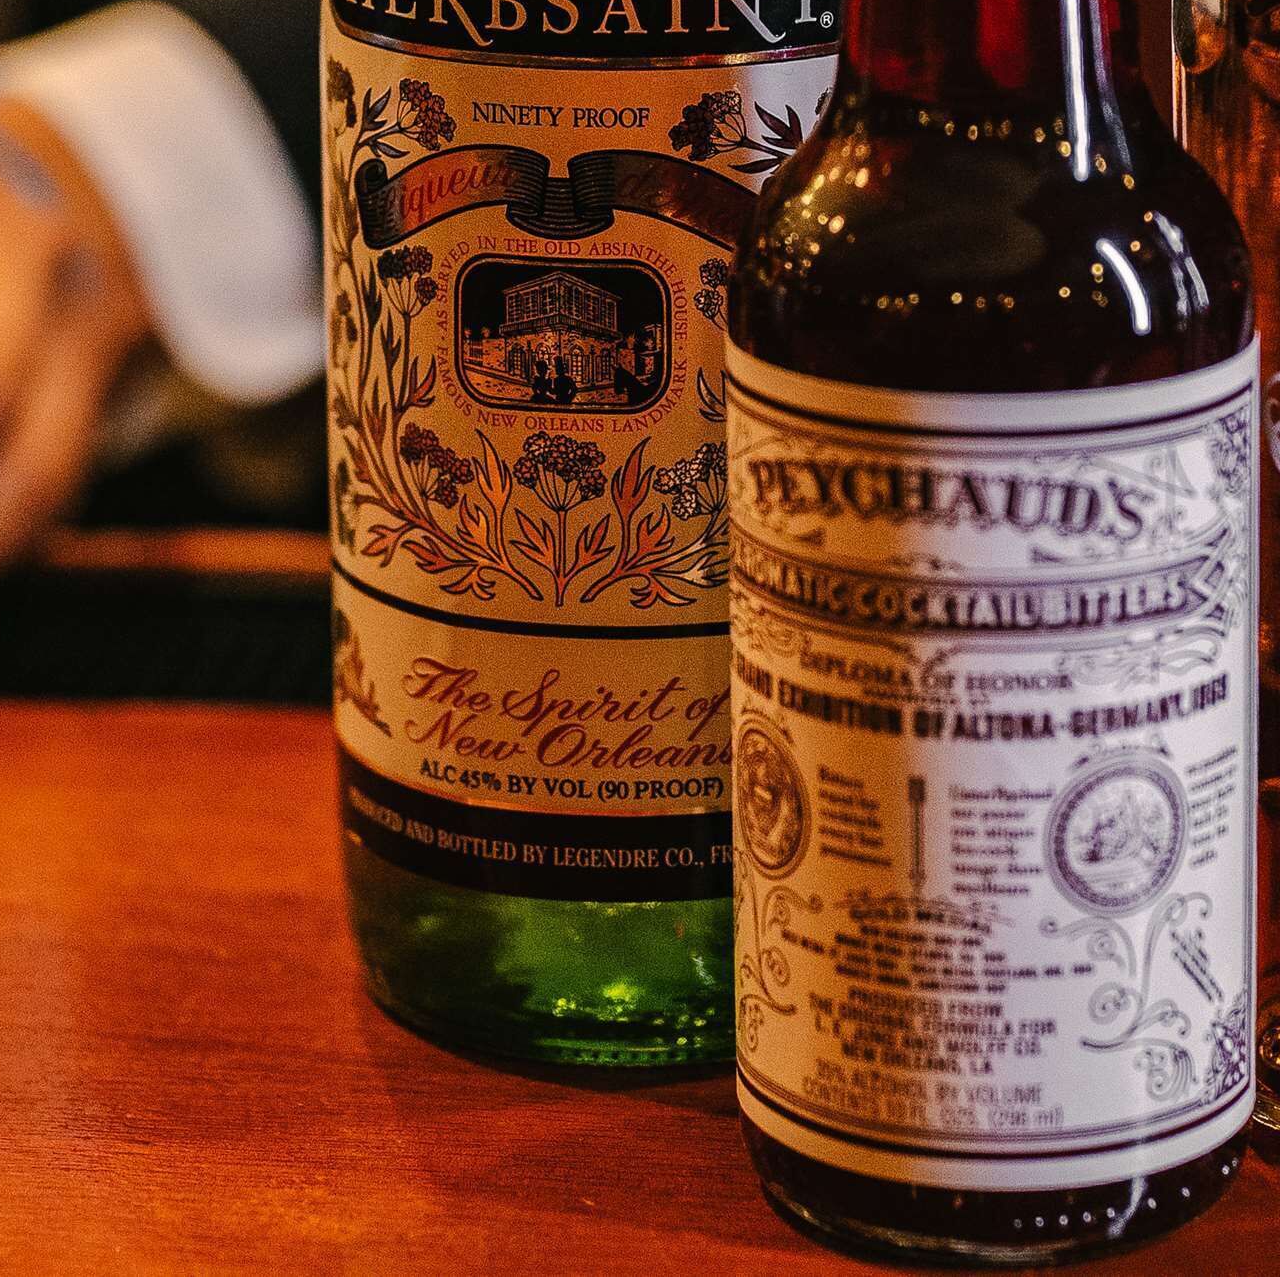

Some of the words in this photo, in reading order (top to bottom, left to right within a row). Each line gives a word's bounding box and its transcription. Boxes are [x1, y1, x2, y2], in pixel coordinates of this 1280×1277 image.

[471, 101, 564, 129] NINETY
[572, 106, 652, 129] PROOF
[478, 235, 497, 251] IN
[503, 238, 538, 253] THE
[544, 241, 581, 255] OLD
[588, 241, 679, 278] ABSINTHE
[436, 240, 470, 305] SERVED
[436, 309, 449, 333] AS
[672, 280, 688, 341] HOUSE
[436, 345, 471, 416] FAMOUS
[477, 411, 517, 429] NEW
[524, 417, 604, 433] ORLEANS
[611, 357, 688, 433] LANDMARK
[749, 460, 1154, 540] PEYCHAUD'S
[403, 656, 491, 713] The
[502, 668, 688, 737] Spirit
[684, 684, 731, 742] of
[404, 709, 522, 762] New
[537, 722, 733, 770] Orleans
[421, 757, 457, 784] ALC
[459, 769, 502, 792] 45%
[508, 774, 537, 795] BY
[543, 778, 592, 798] VOL
[597, 779, 629, 802] (90
[633, 776, 724, 800] PROOF)
[406, 819, 434, 844] AND
[438, 829, 516, 861] BOTTLED
[523, 843, 547, 864] BY
[553, 846, 659, 867] LEGENDRE
[665, 846, 705, 868] CO.,
